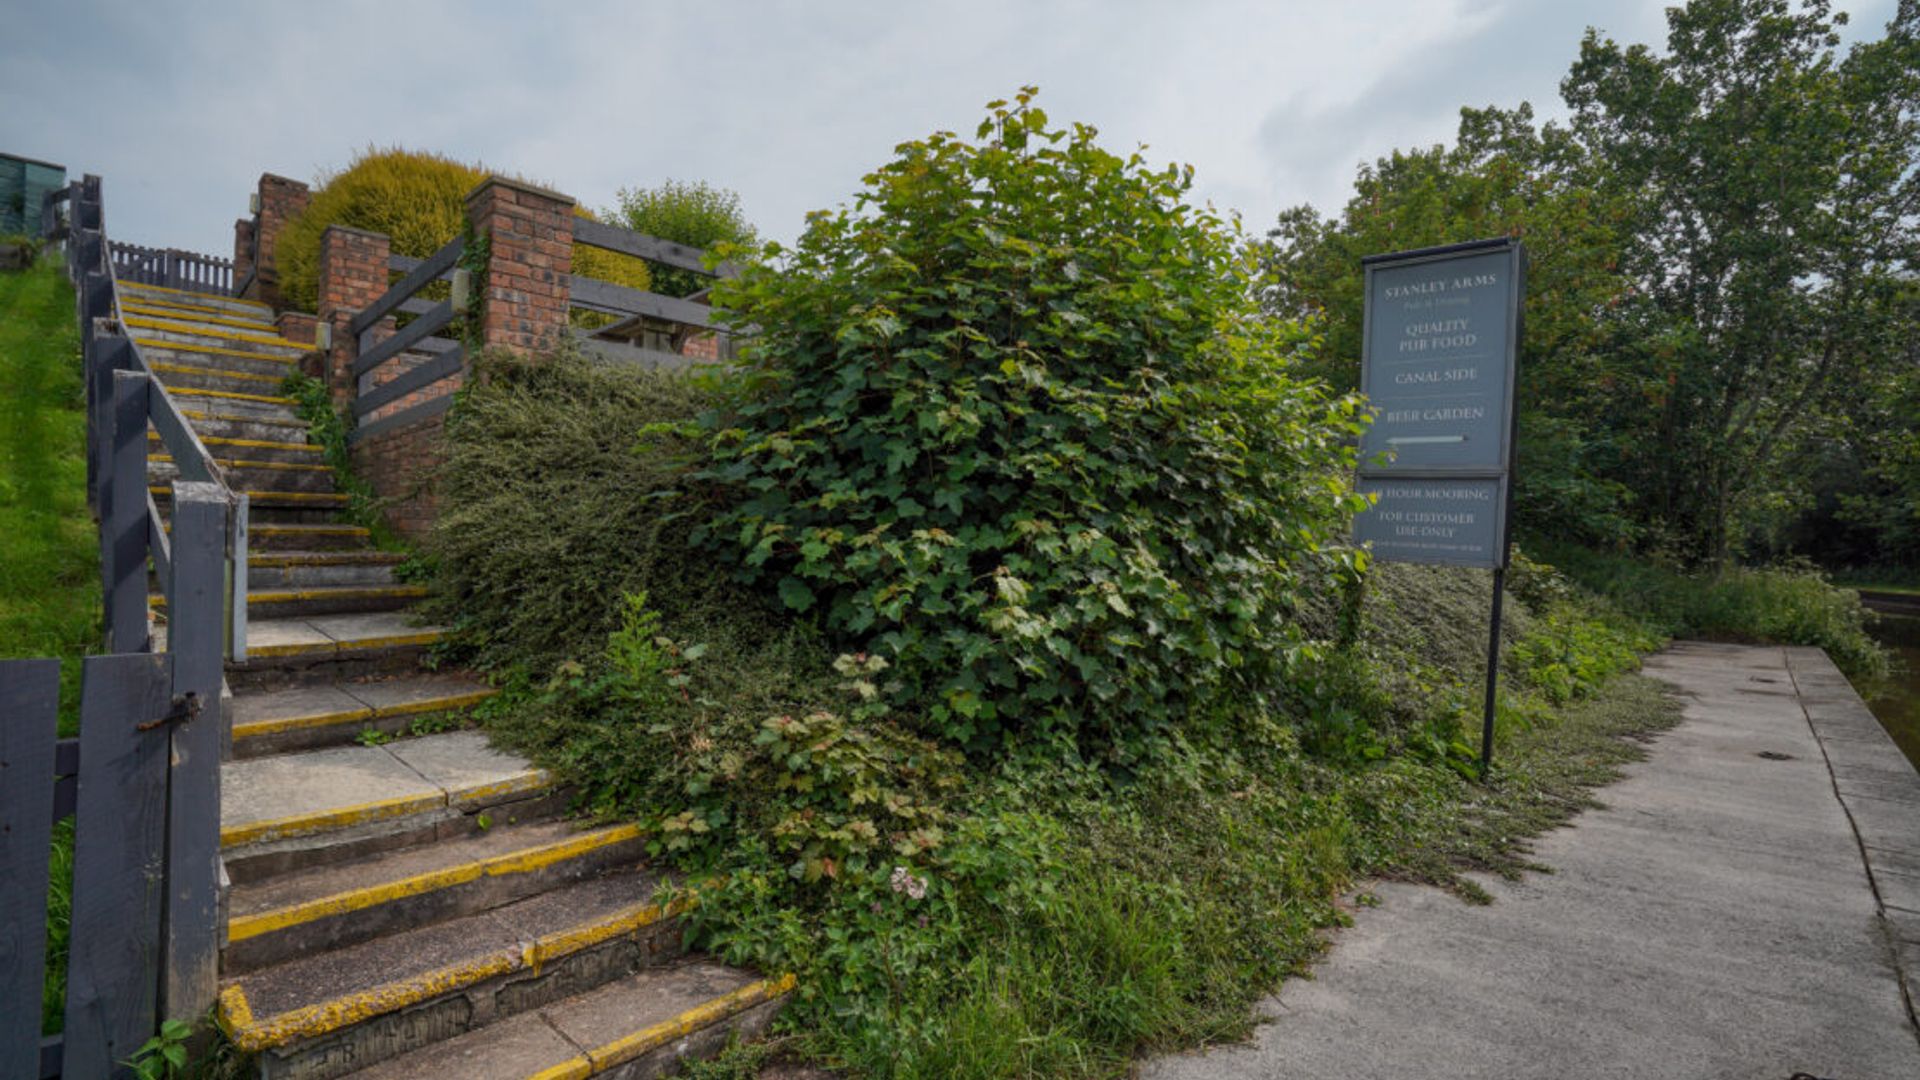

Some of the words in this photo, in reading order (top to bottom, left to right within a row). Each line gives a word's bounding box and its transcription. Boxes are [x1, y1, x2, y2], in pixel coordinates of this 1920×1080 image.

[1385, 281, 1446, 300] STANLEY
[1451, 274, 1497, 289] ARMS
[1406, 317, 1469, 336] QUALITY
[1399, 339, 1428, 353] PUB
[1432, 334, 1477, 350] FOOD
[1395, 371, 1441, 384] CANAL
[1444, 367, 1477, 381] SIDE
[1387, 410, 1420, 423] BEER
[1423, 407, 1484, 421] GARDEN
[1387, 487, 1422, 498] HOUR
[1425, 488, 1489, 500] MOORING
[1379, 512, 1402, 522] FOR
[1406, 512, 1475, 524] CUSTOMER
